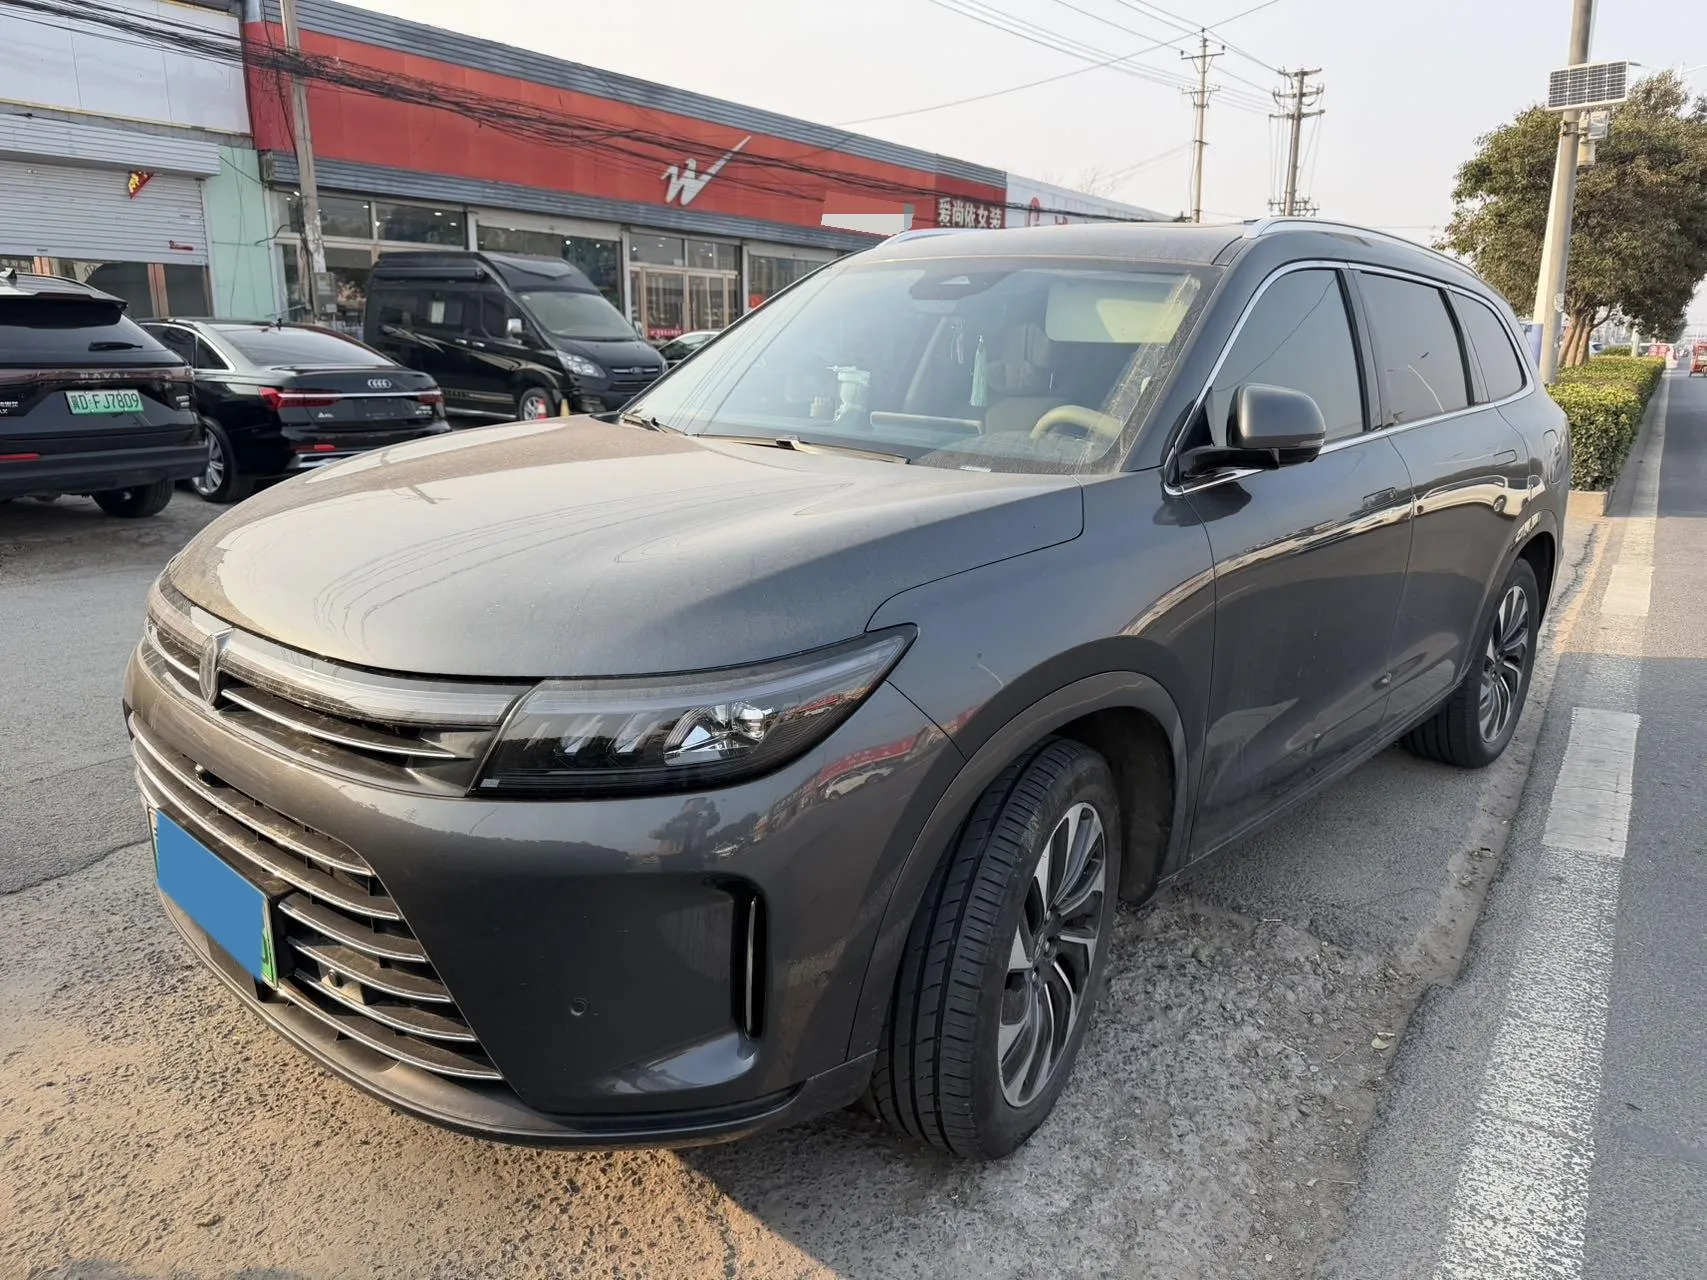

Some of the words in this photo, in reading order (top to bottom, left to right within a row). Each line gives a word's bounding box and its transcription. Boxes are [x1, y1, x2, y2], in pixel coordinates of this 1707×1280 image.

[938, 197, 1002, 229] 爱尚依女装
